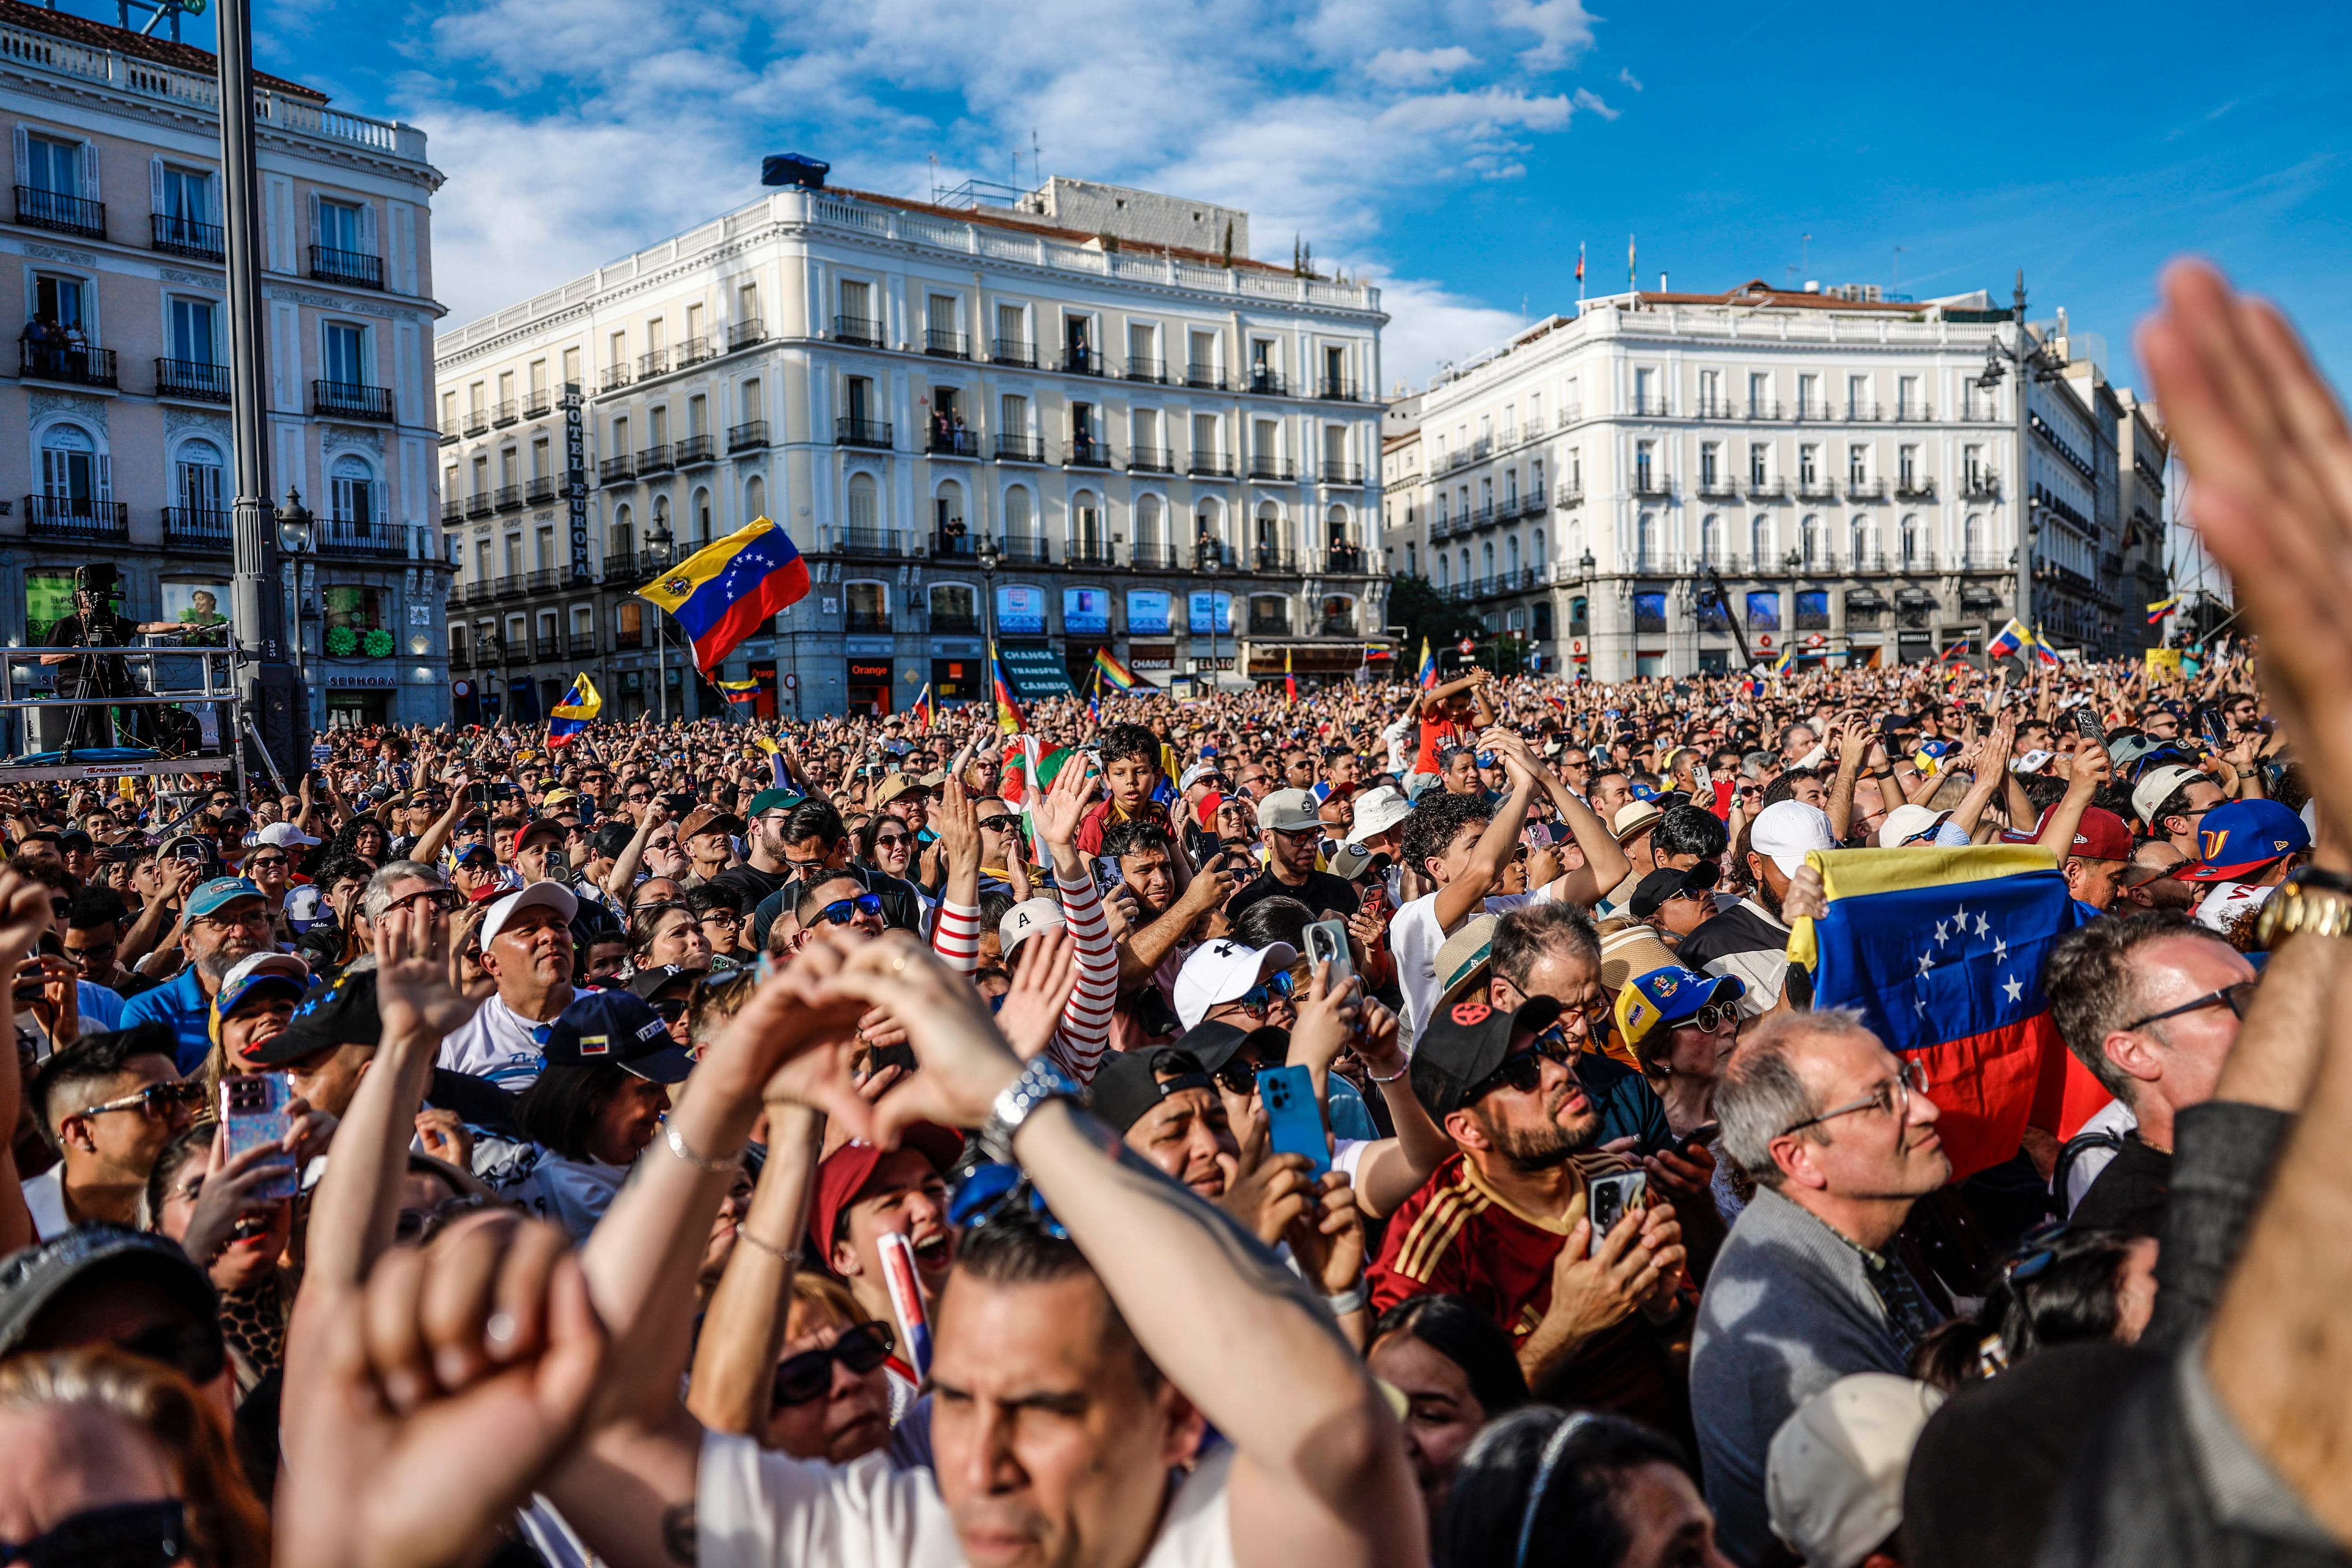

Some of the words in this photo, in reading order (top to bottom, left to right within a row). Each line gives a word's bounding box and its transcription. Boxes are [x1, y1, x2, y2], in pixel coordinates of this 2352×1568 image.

[566, 393, 583, 471] HOTEL
[571, 483, 588, 576] EUROPA
[1003, 651, 1054, 660] CHANGE
[1131, 659, 1170, 669] CHANGE
[752, 669, 775, 679] Orange
[852, 665, 888, 677] Orange
[328, 677, 395, 686] SEPHORA
[1019, 682, 1069, 690] CAMBIO
[307, 899, 324, 917] V
[1018, 911, 1032, 928] A
